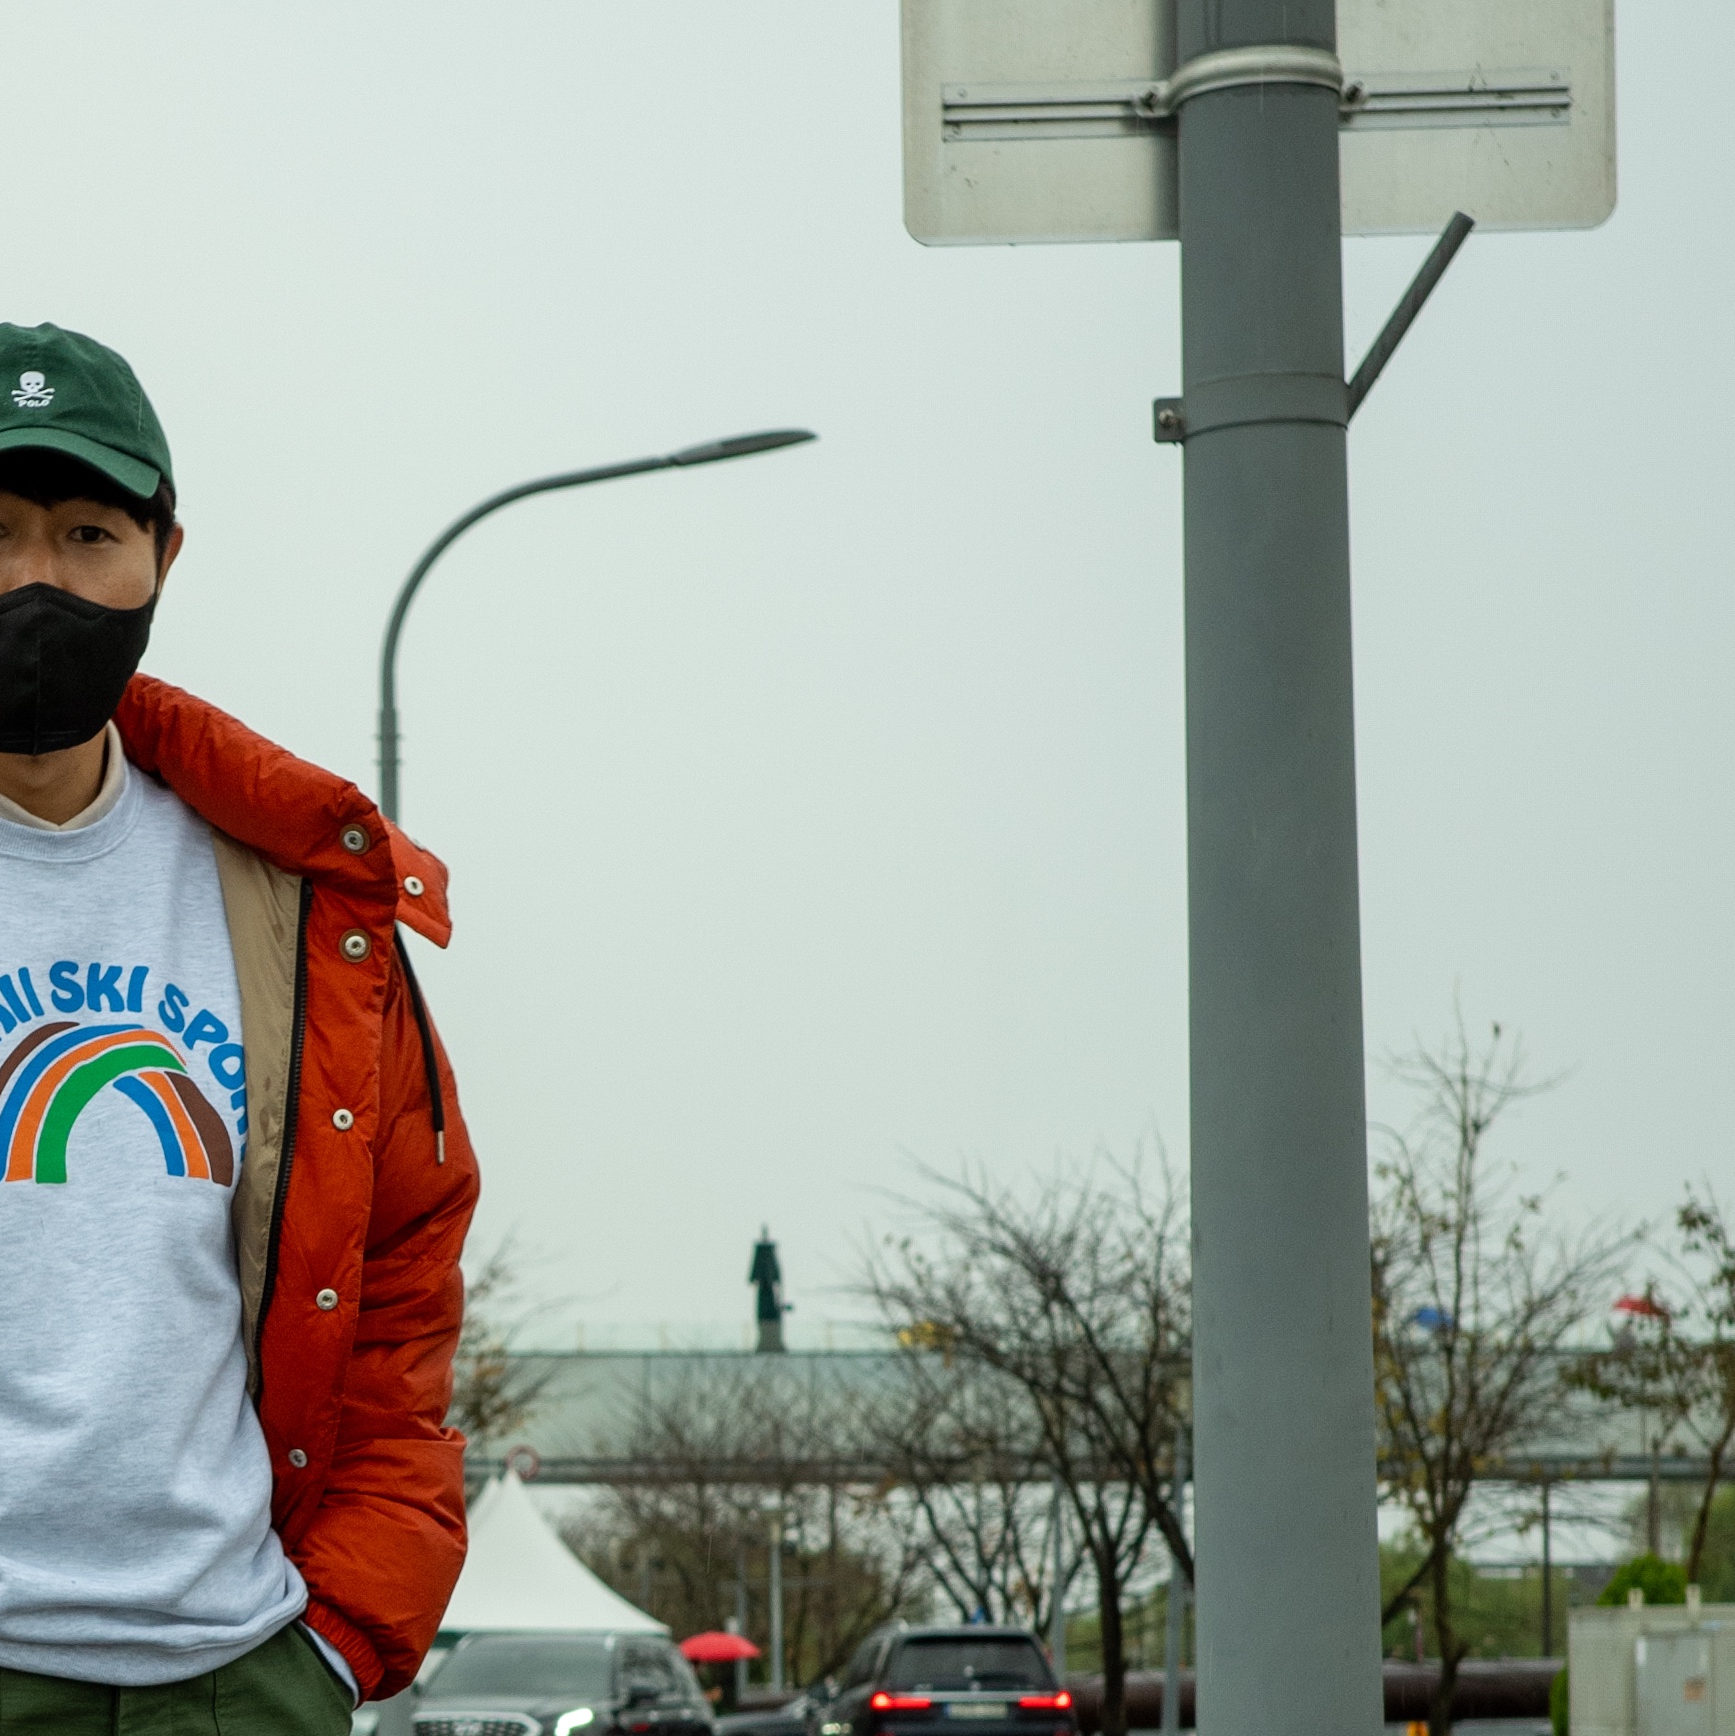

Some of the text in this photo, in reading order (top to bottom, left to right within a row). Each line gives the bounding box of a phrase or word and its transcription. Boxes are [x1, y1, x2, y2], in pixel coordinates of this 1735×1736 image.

[17, 399, 50, 407] POLO
[49, 960, 149, 1013] SKI
[158, 982, 249, 1163] SPO
